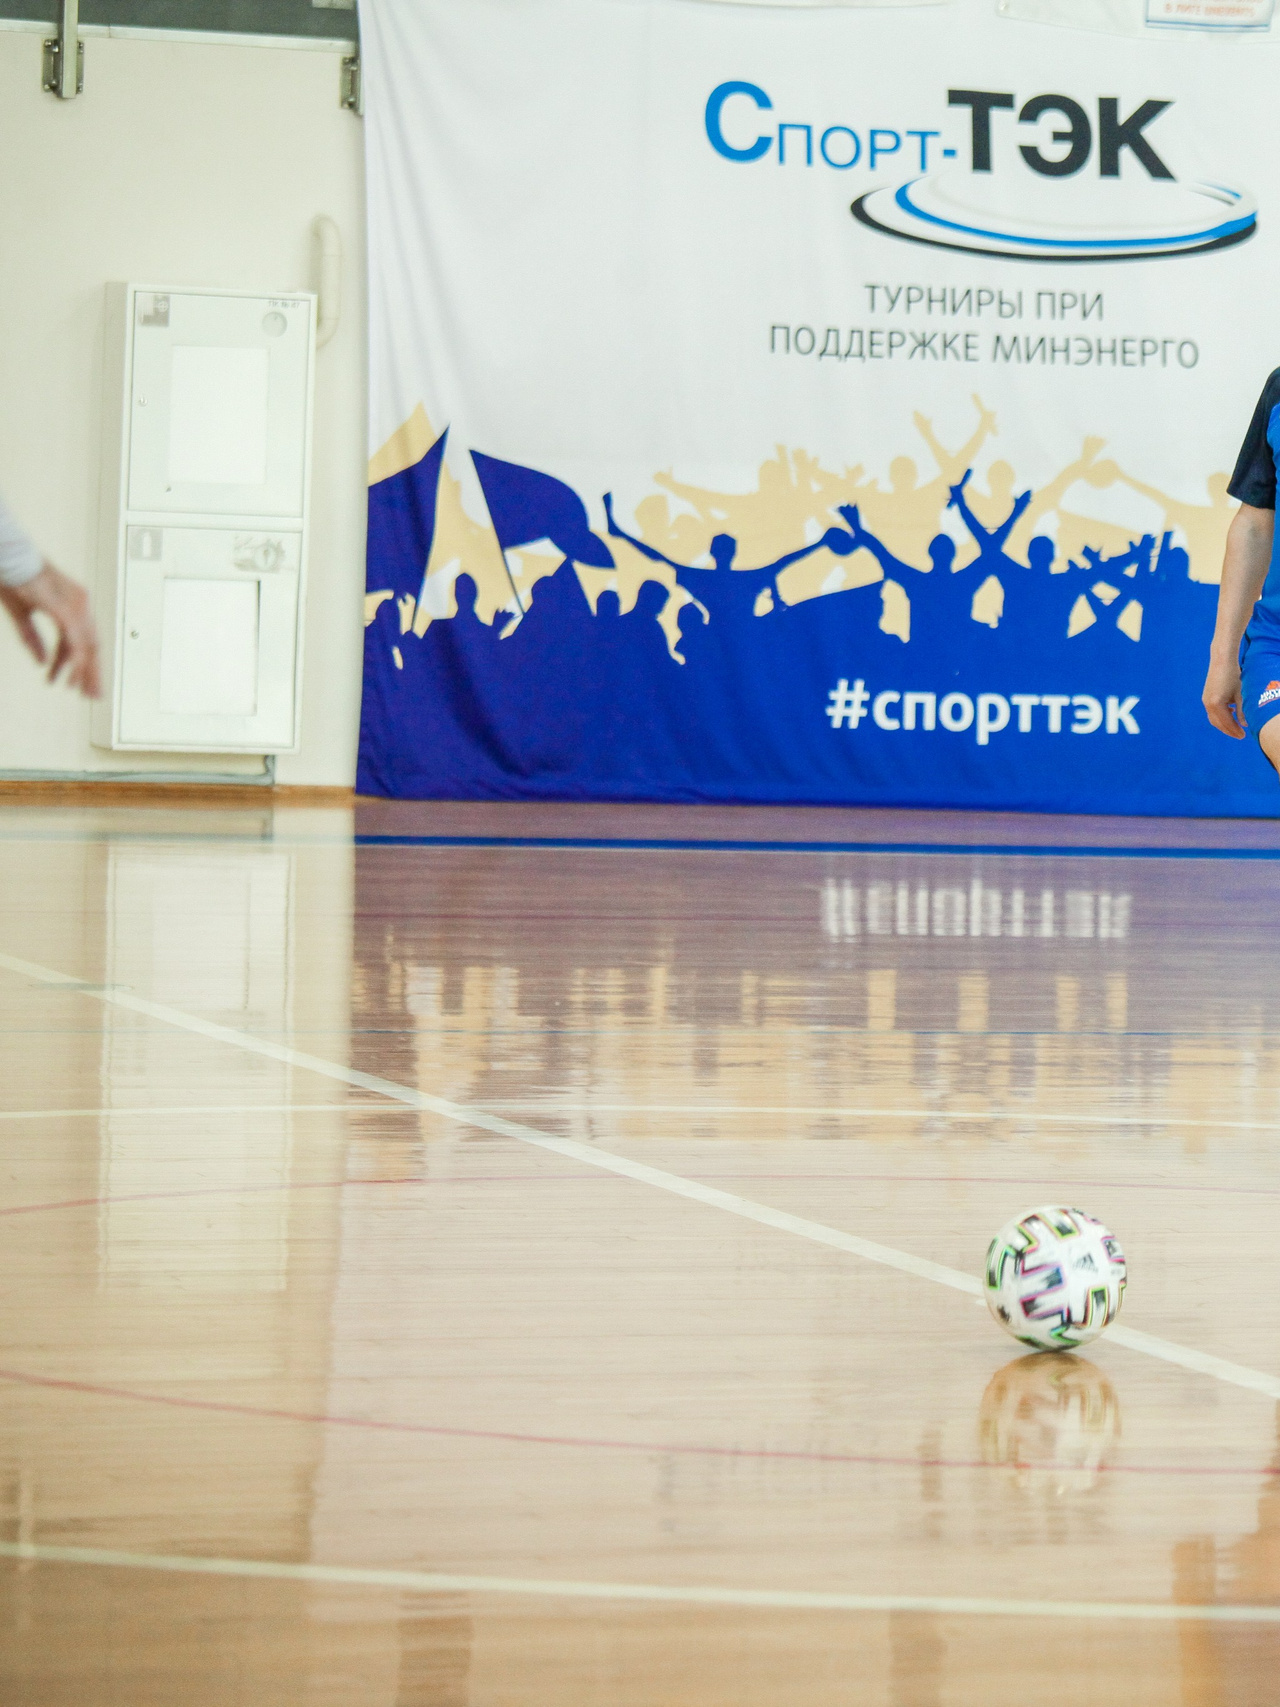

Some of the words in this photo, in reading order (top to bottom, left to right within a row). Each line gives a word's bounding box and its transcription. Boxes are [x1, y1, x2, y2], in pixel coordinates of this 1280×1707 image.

[864, 284, 1024, 320] ТУРНИРЫ
[1036, 291, 1105, 322] ПРИ
[770, 324, 979, 363] ПОДДЕРЖКЕ
[992, 334, 1200, 370] МИНЭНЕРГО
[825, 678, 1142, 746] #спорттэк
